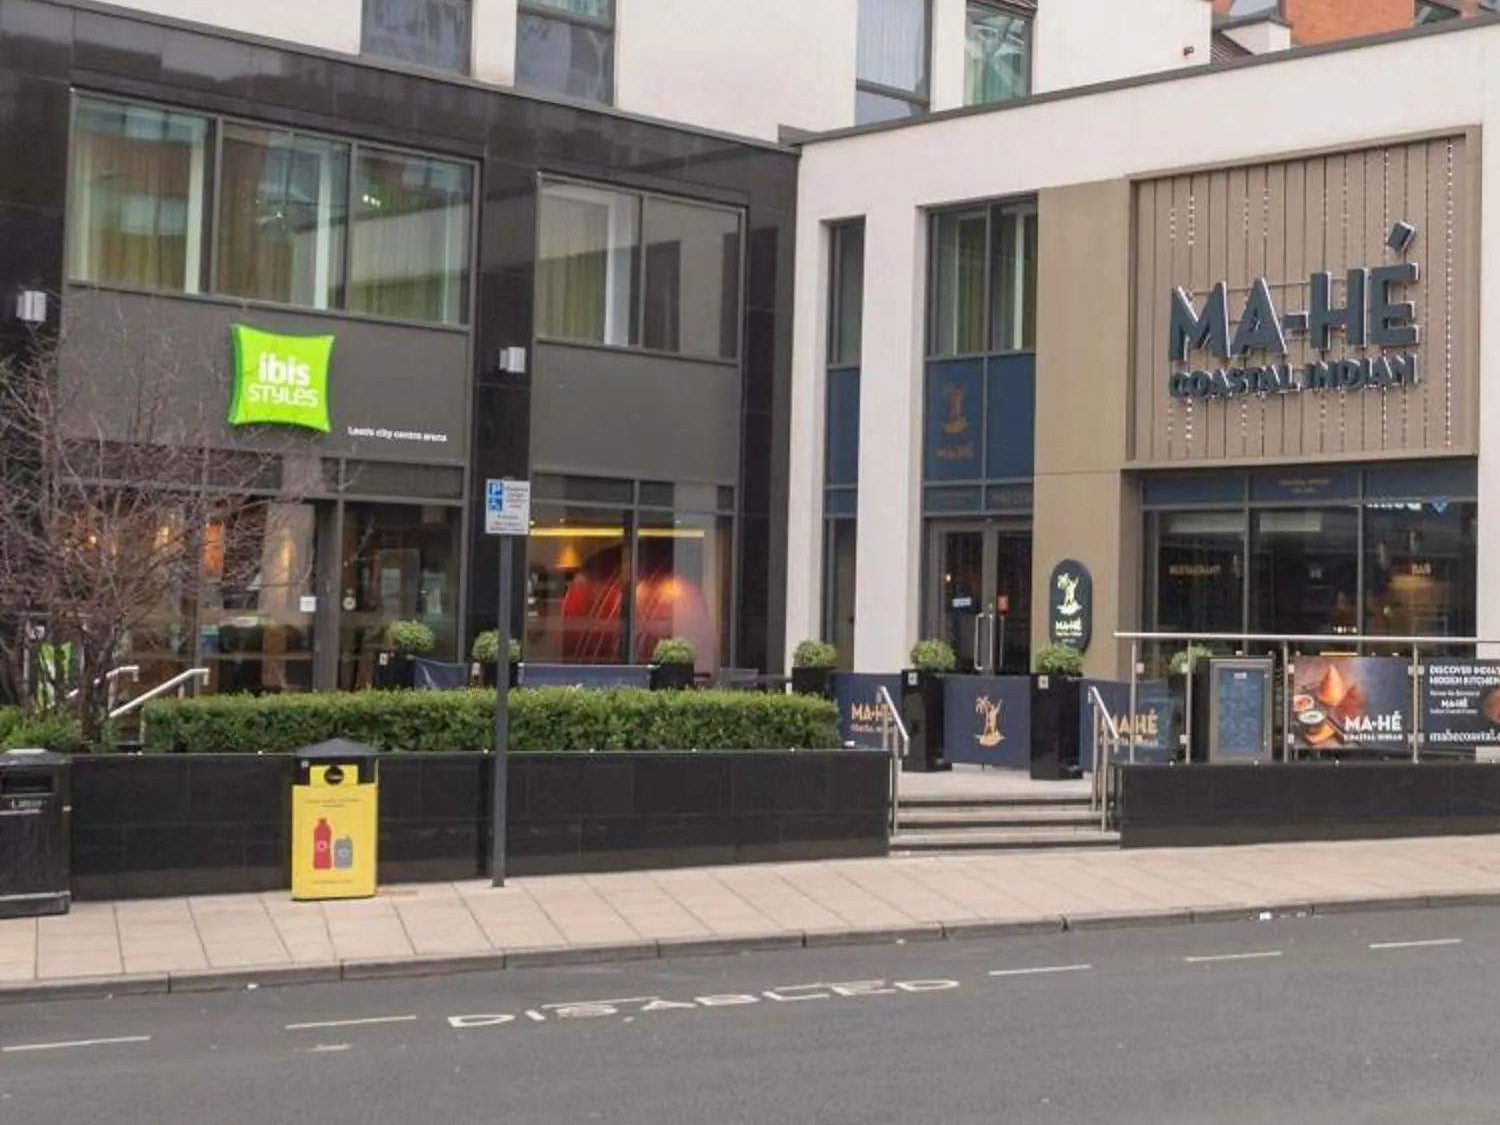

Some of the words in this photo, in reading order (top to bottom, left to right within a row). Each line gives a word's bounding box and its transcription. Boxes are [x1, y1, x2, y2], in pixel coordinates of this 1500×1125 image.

[1169, 220, 1419, 362] MA-HÉ
[258, 351, 311, 387] ibis
[1169, 363, 1300, 400] COASTAL
[1304, 353, 1419, 393] INDIAN
[1344, 710, 1403, 732] MA-HÉ
